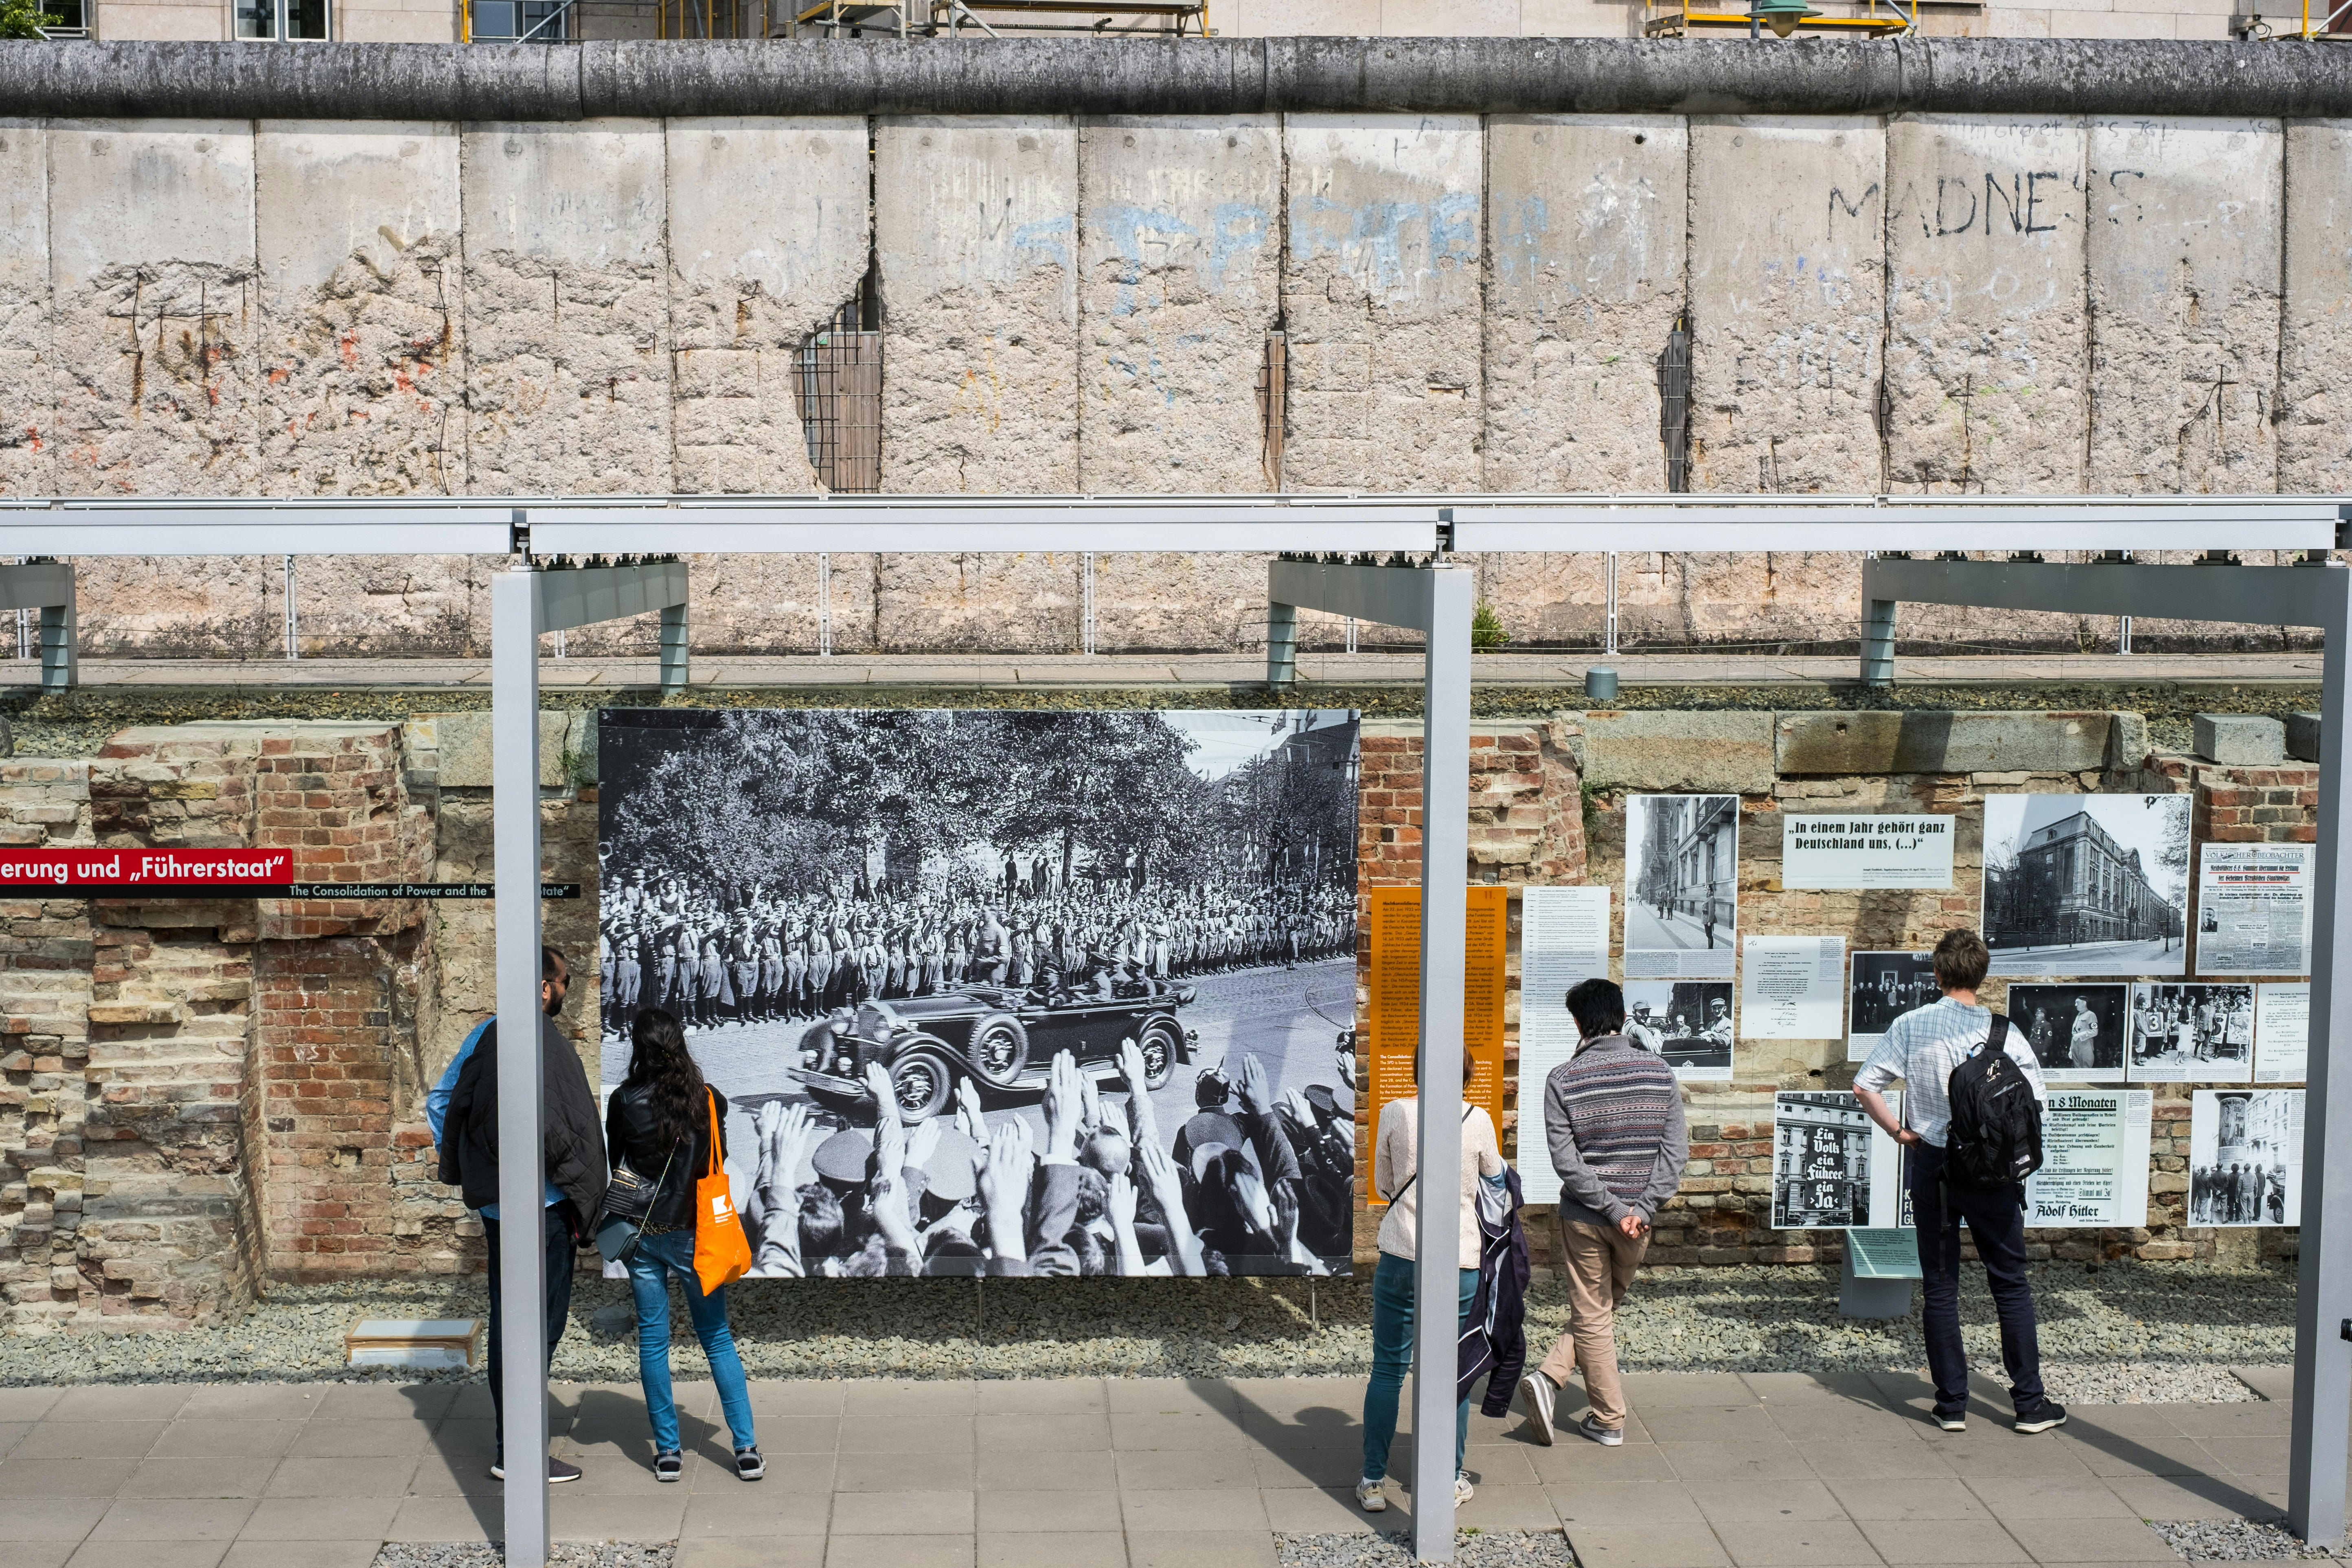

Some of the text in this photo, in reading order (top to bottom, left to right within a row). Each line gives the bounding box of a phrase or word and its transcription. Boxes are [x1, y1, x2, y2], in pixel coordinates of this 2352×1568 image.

[1811, 822, 1845, 833] einem
[1849, 822, 1873, 835] Jahr
[1878, 822, 1914, 834] gehört
[1919, 822, 1945, 834] ganz
[1795, 838, 1863, 849] Deutschland
[1869, 839, 1891, 850] uns,
[78, 855, 120, 878] und
[130, 854, 284, 882] „Führerstaat“
[290, 885, 310, 896] The
[313, 885, 389, 896] Consolidation
[392, 885, 404, 896] of
[407, 886, 443, 896] Power
[445, 885, 467, 896] and
[471, 885, 487, 896] the
[2149, 1015, 2159, 1030] 3
[2058, 1097, 2066, 1107] 8
[2069, 1096, 2116, 1108] Monaten
[1814, 1127, 1835, 1140] Ein
[1813, 1140, 1839, 1154] Volk
[1817, 1154, 1835, 1166] ein
[1807, 1163, 1843, 1181] Führer
[1816, 1181, 1834, 1192] ein
[2035, 1205, 2099, 1219] Adolf Hitler
